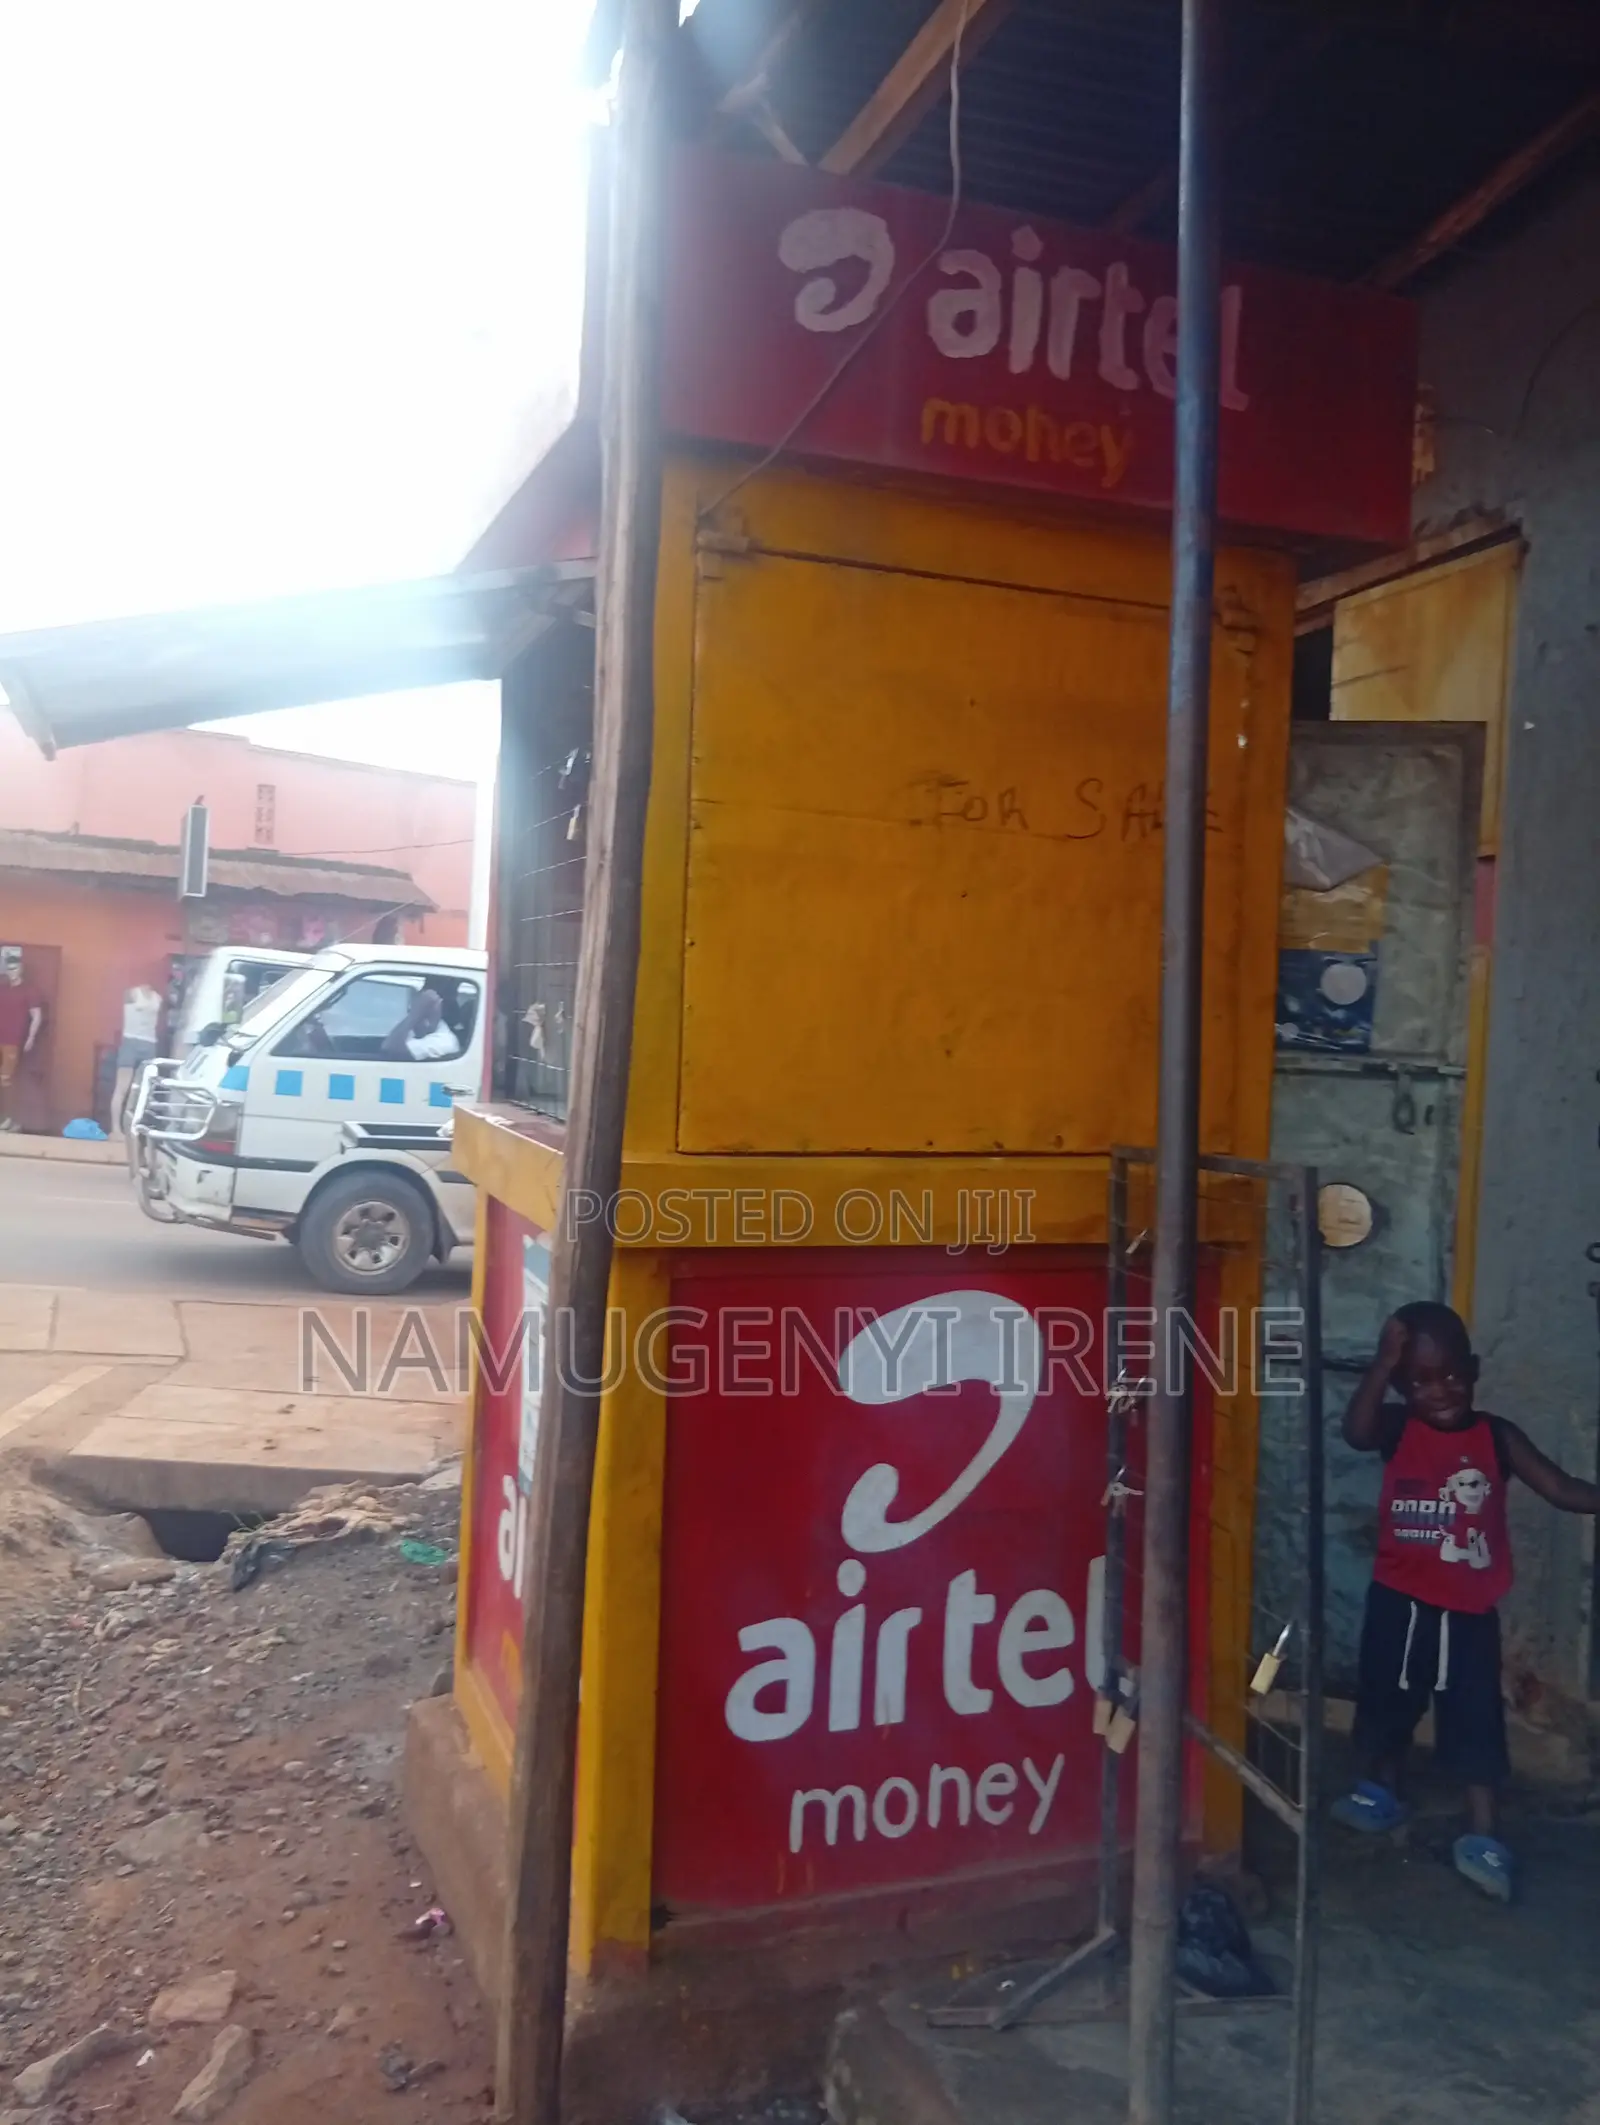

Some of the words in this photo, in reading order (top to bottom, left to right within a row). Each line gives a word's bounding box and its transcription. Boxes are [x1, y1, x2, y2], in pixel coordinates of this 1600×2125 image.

[926, 226, 1249, 412] airtel
[921, 398, 1135, 488] money
[932, 774, 1029, 831] FOR
[725, 1555, 1106, 1741] airtel
[789, 1753, 1065, 1853] money
